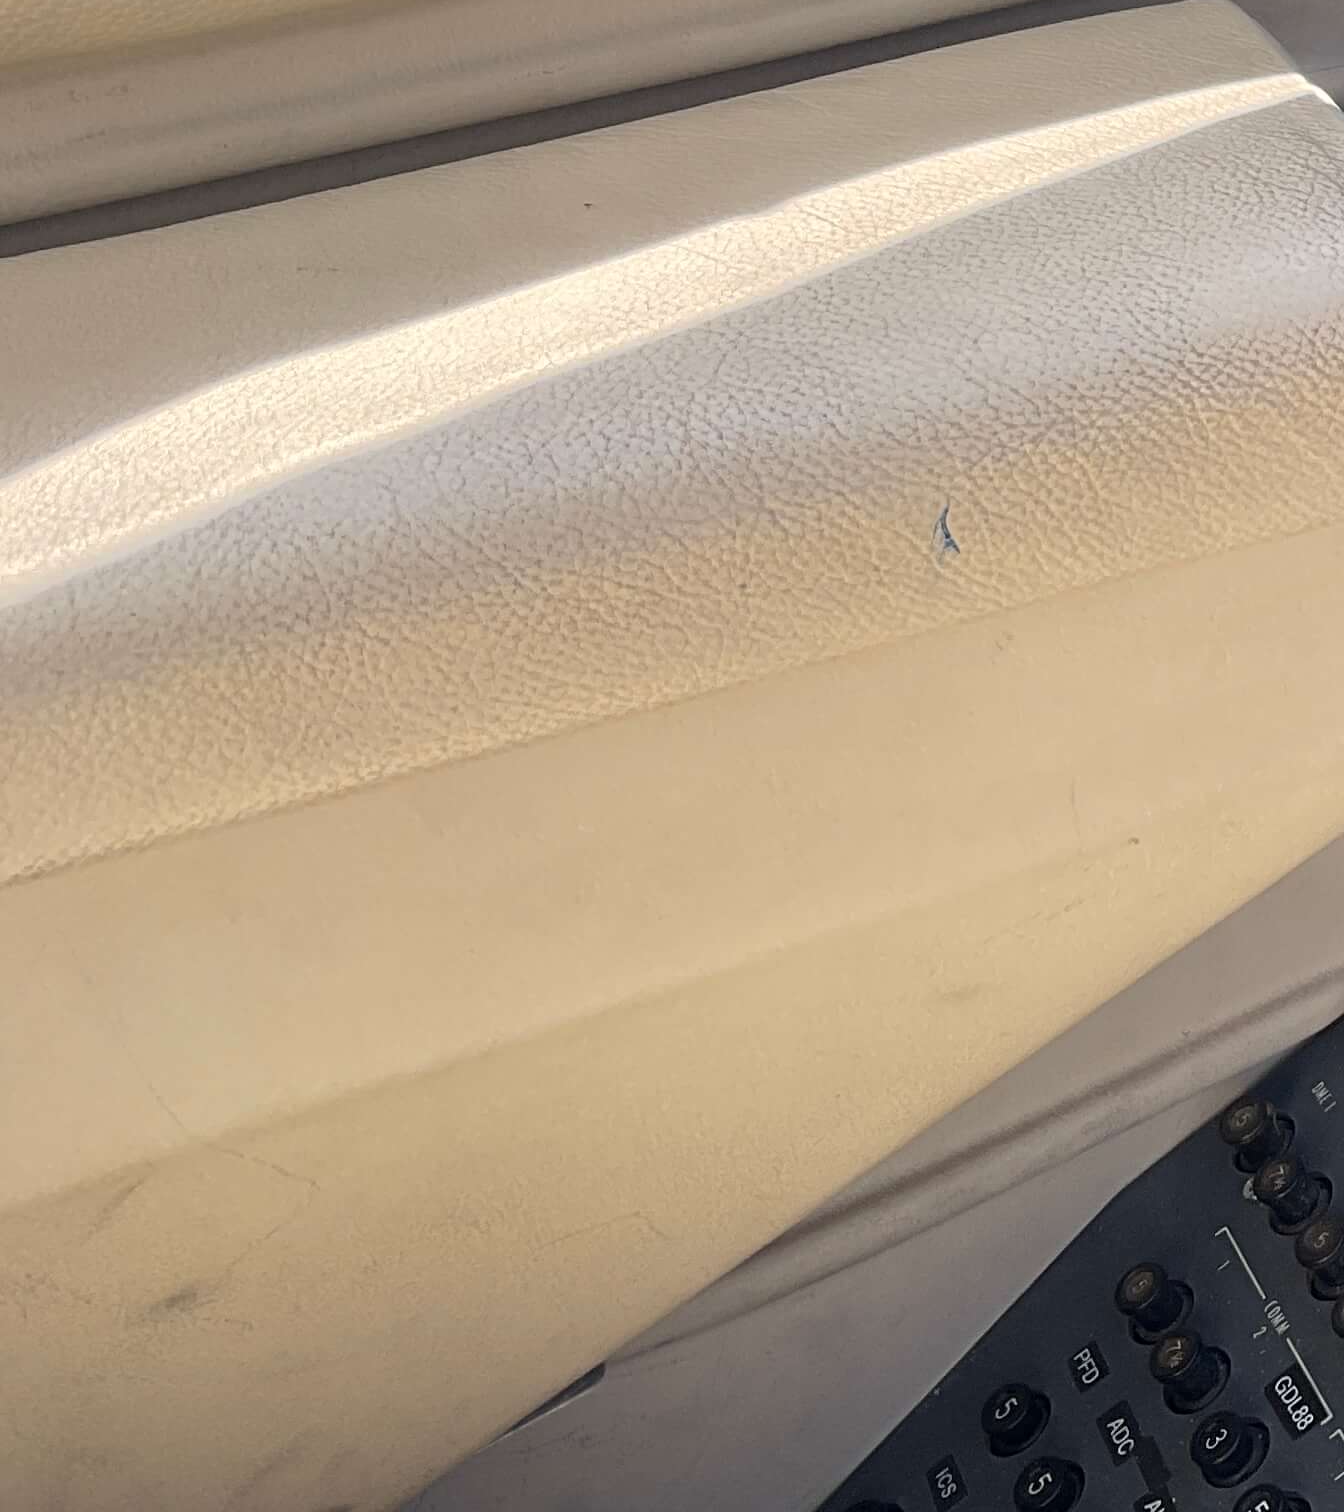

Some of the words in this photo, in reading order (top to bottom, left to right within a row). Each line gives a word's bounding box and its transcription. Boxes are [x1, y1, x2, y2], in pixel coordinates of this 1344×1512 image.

[1073, 1347, 1099, 1385] PFD
[1274, 1376, 1314, 1430] GDL88
[1106, 1418, 1136, 1456] ADC
